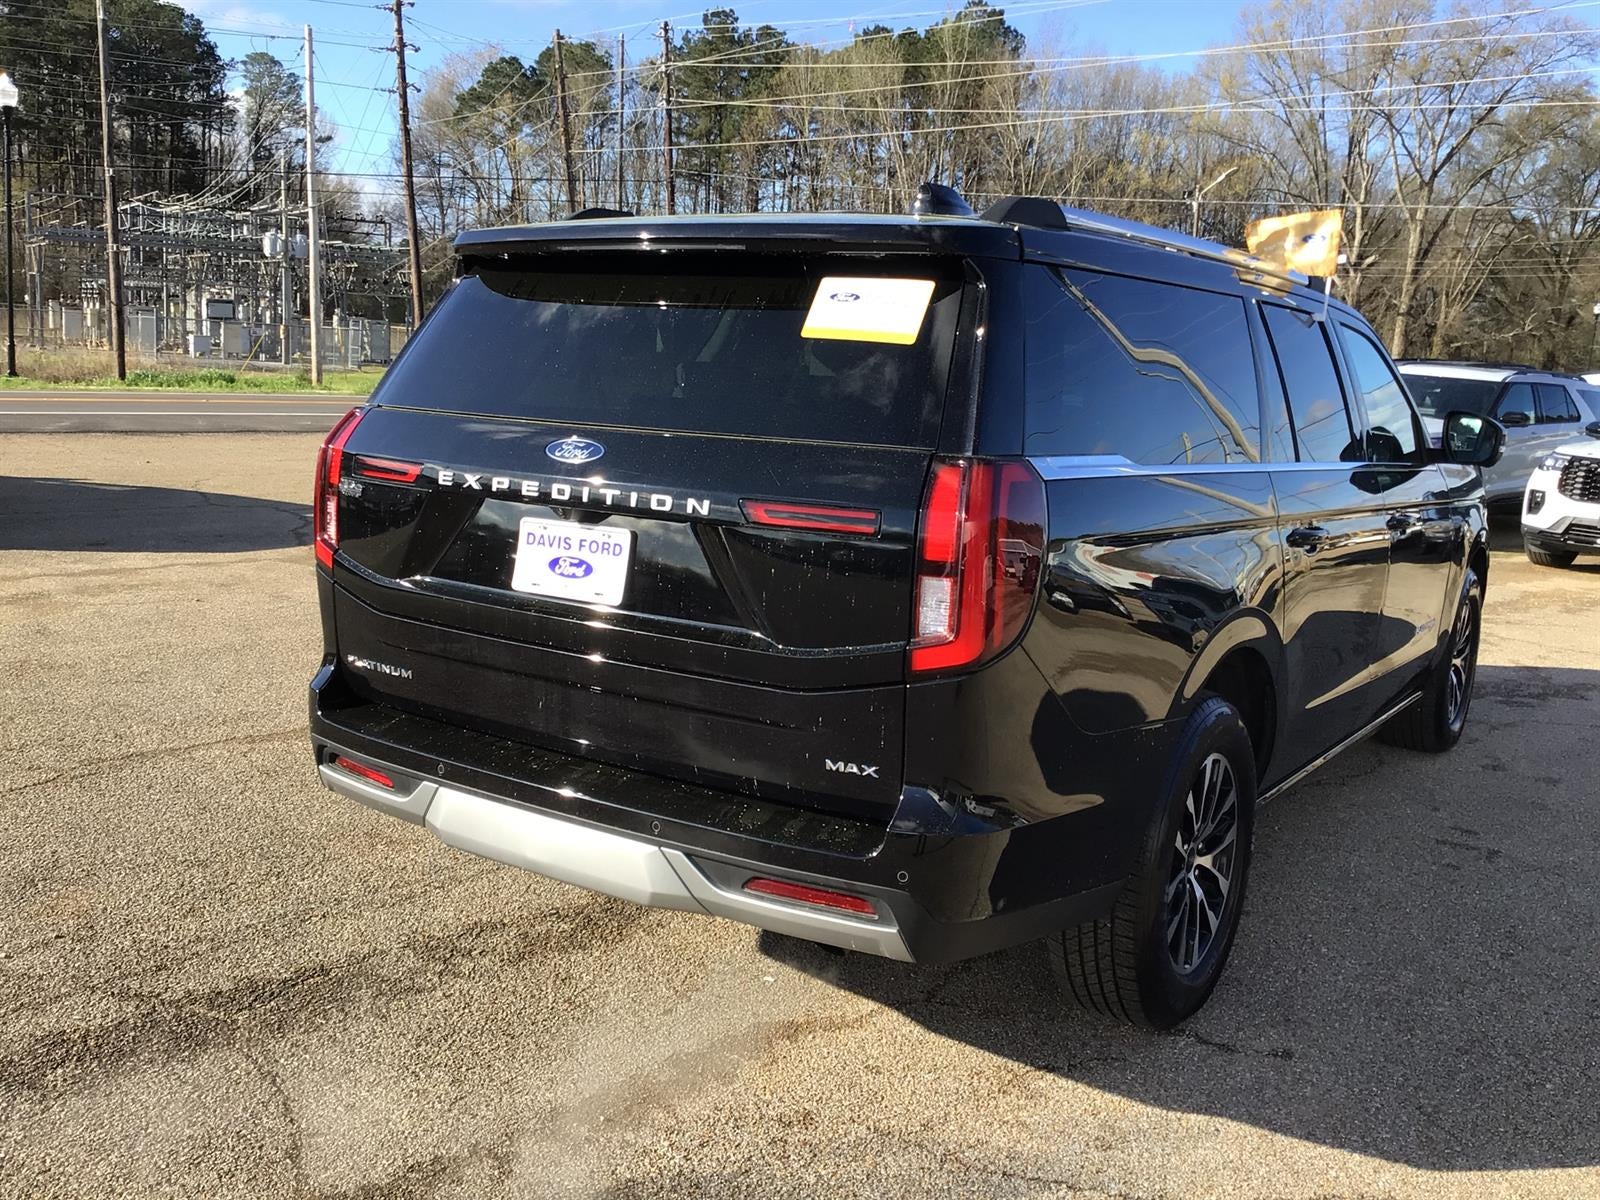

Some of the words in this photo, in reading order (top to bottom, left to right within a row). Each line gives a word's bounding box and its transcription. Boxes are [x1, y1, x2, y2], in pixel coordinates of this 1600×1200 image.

[555, 440, 594, 459] Ford
[438, 470, 710, 516] EXPEDITION
[526, 532, 572, 550] DAVIS
[579, 538, 623, 557] FORD
[554, 557, 587, 577] Ford
[825, 758, 880, 779] MAX
